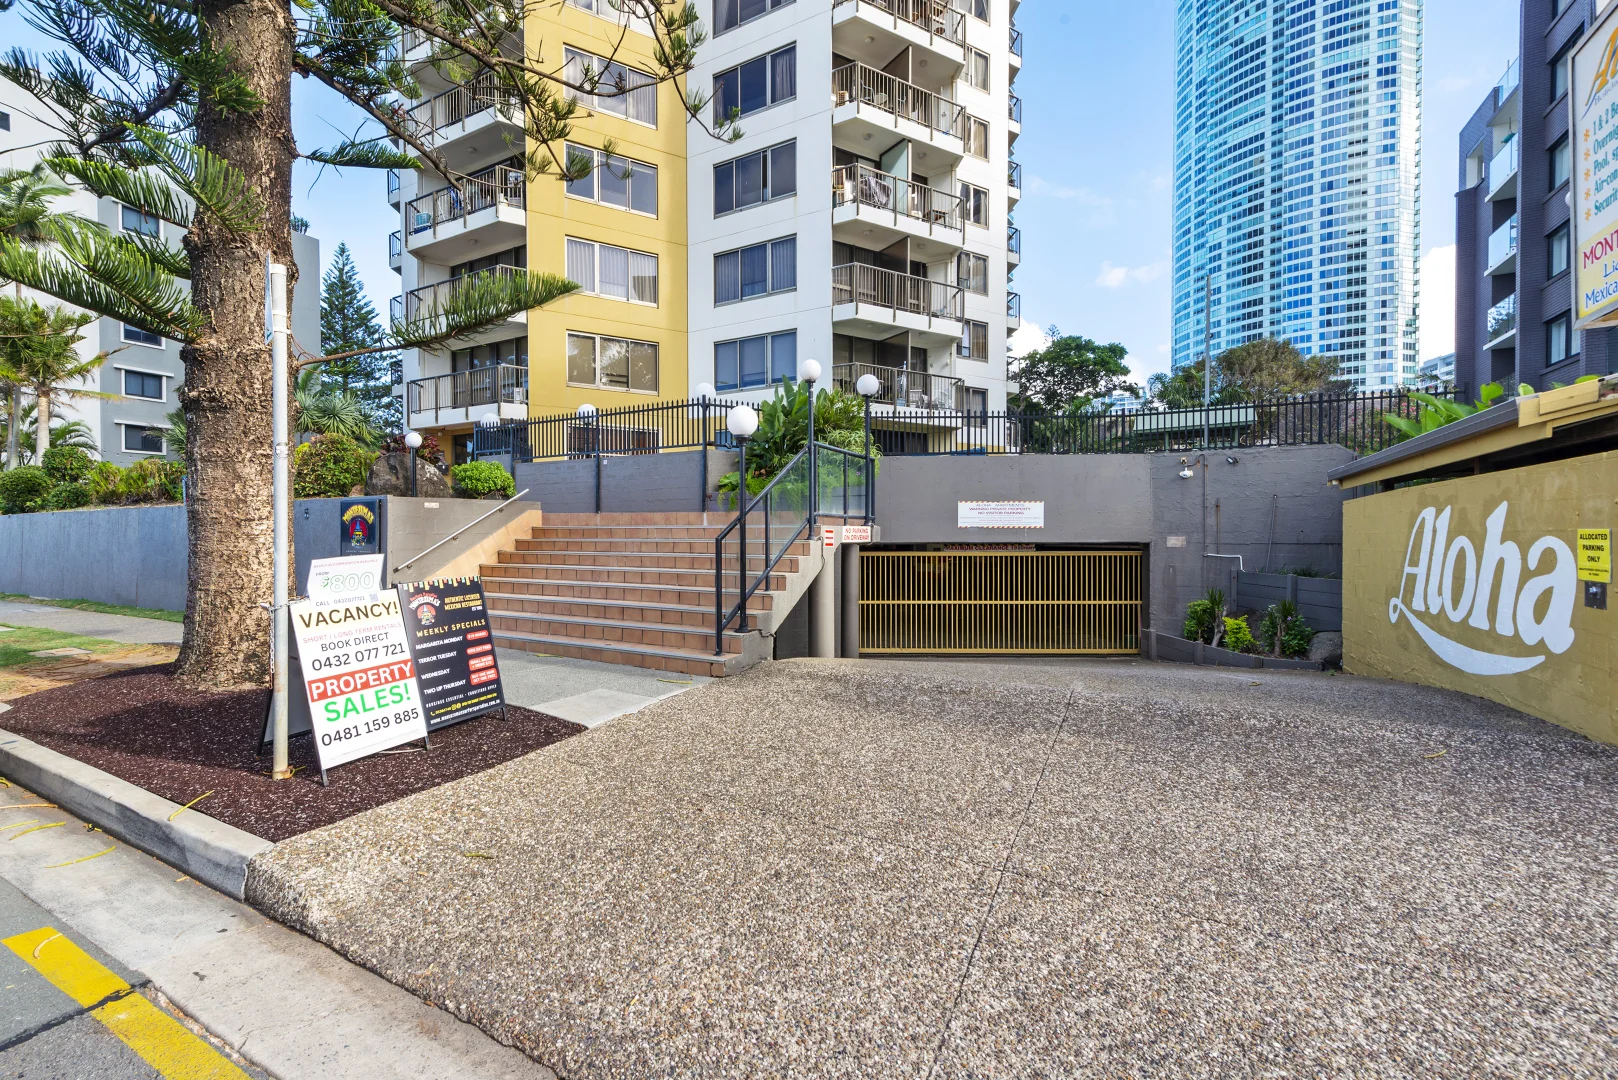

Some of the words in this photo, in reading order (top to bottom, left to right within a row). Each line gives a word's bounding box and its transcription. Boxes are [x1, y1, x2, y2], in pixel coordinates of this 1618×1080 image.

[1593, 120, 1597, 136] 1
[1598, 115, 1603, 131] &
[1605, 108, 1609, 125] 2
[1593, 151, 1610, 176] Pool,
[1582, 544, 1604, 552] PARKING
[320, 572, 374, 593] $800
[1389, 500, 1577, 654] Aloha
[299, 601, 398, 628] VACANCY!
[444, 602, 461, 610] MEXICAN
[461, 600, 482, 609] RESTAURANT
[302, 634, 327, 644] SHORT
[334, 630, 354, 638] LONG
[355, 626, 372, 634] TERM
[374, 622, 402, 633] RENTALS
[416, 626, 448, 637] WEEKLY
[451, 619, 486, 631] SPECIALS
[321, 639, 352, 652] BOOK
[354, 632, 389, 646] DIRECT
[416, 638, 443, 649] MARGARITA
[444, 636, 463, 645] MONDAY
[312, 654, 351, 671] 0432
[355, 647, 379, 662] 077
[382, 643, 406, 656] 721
[418, 655, 436, 664] TERROR
[437, 651, 457, 660] TUESDAY
[311, 662, 412, 700] PROPERTY
[421, 668, 450, 680] WEDNESDAY
[443, 679, 466, 689] THURSDAY
[324, 683, 410, 722] SALES!
[321, 725, 361, 746] 0481
[364, 716, 390, 734] 159
[394, 708, 419, 724] 885
